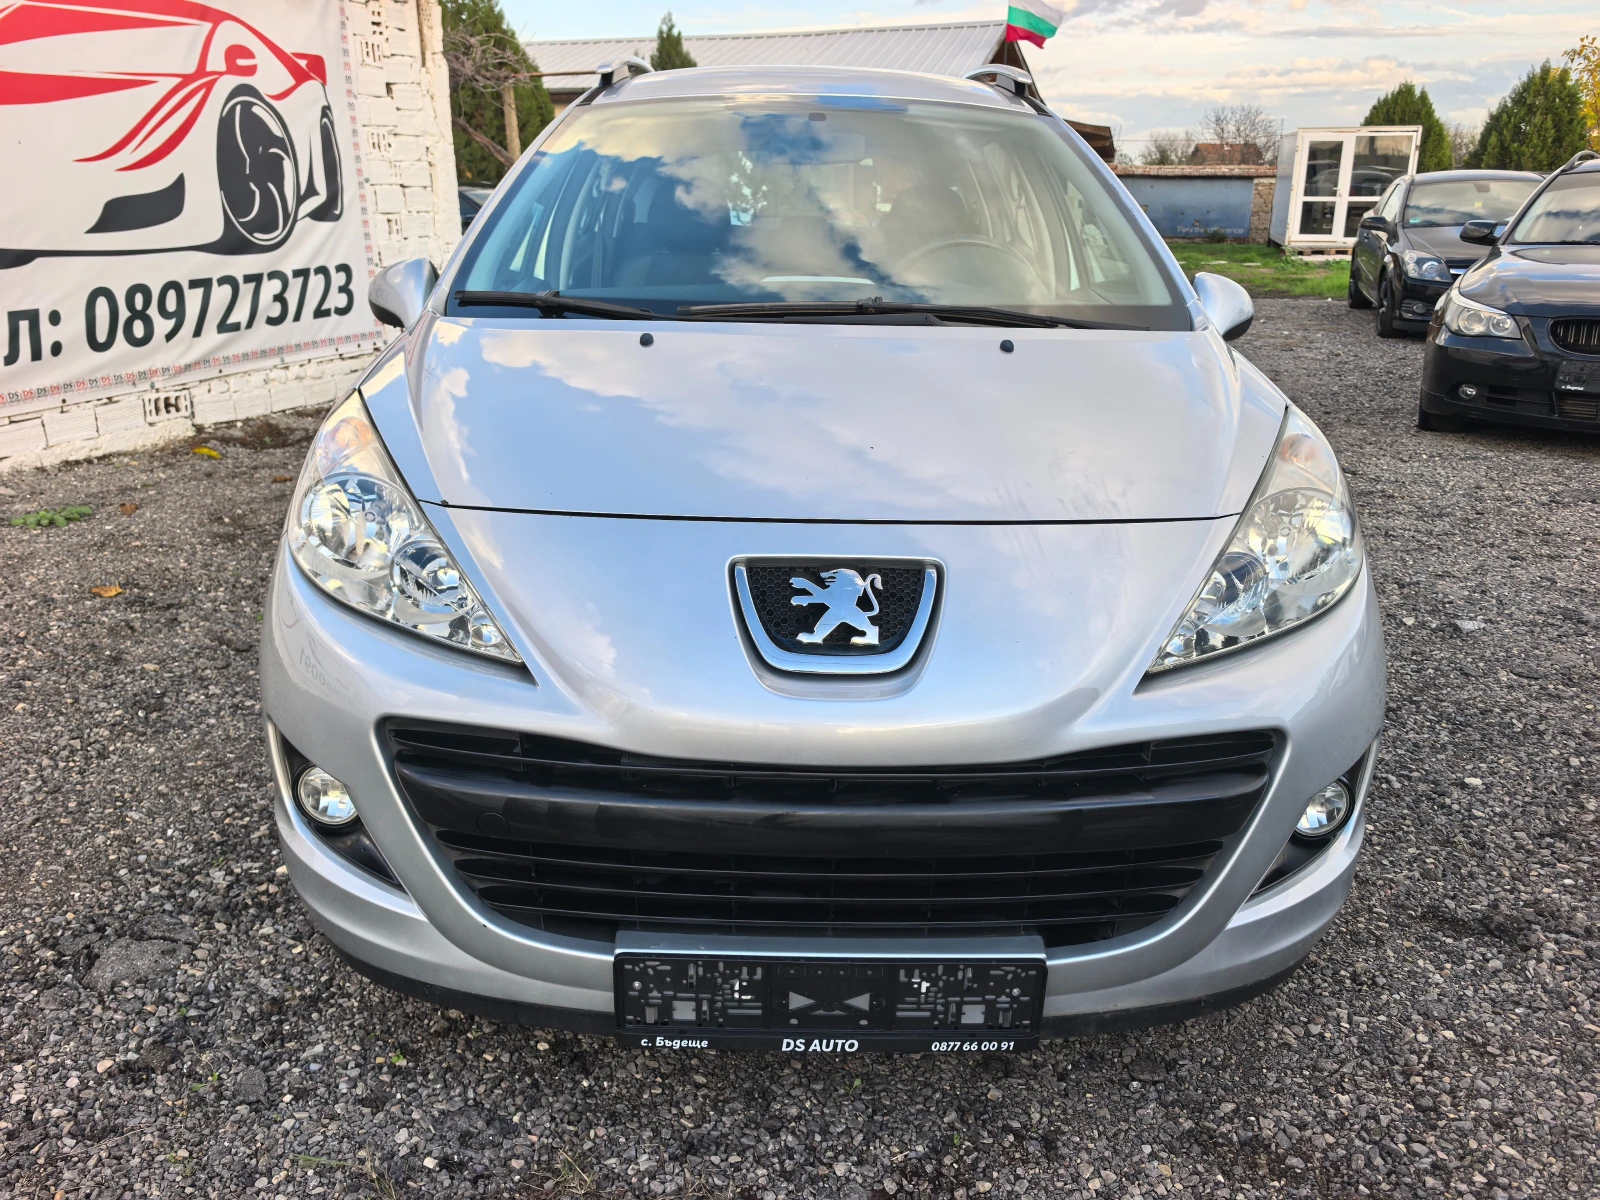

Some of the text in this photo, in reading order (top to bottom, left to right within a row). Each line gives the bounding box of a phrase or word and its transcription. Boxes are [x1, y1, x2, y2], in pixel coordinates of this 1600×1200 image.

[85, 263, 354, 353] 0897273723
[656, 1037, 709, 1050] Бъдеще
[782, 1039, 859, 1052] DS AUTO
[931, 1041, 1015, 1051] 0877 66 00 91
